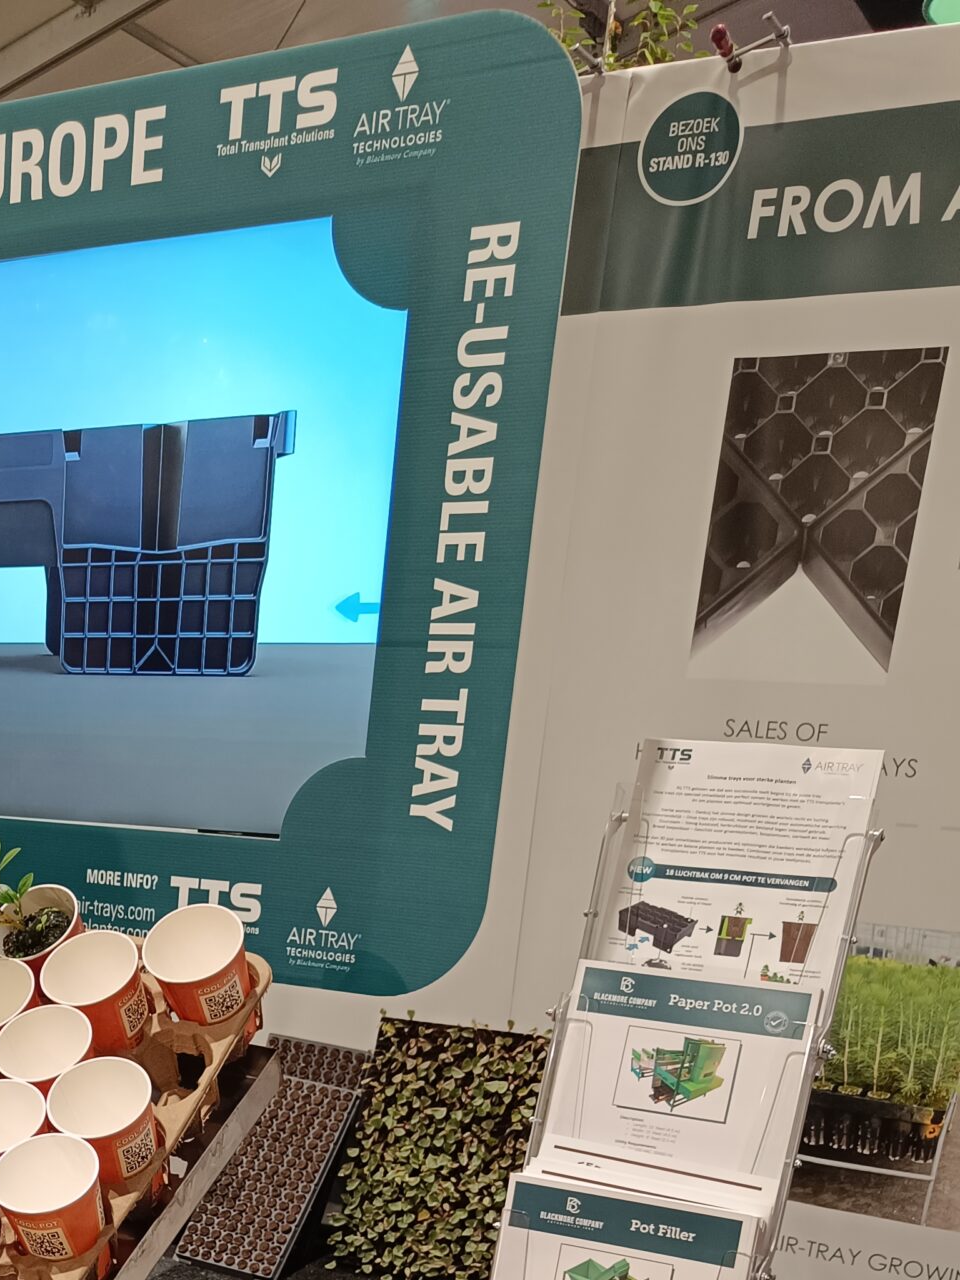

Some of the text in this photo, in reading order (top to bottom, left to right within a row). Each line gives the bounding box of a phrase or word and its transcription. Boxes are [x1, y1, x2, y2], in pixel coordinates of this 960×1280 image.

[219, 67, 339, 141] TTS
[668, 117, 721, 137] BEZOEK
[217, 128, 335, 157] Total Transplant Solutions
[352, 129, 443, 155] TECHNOLOGIES
[677, 135, 706, 153] ONS
[355, 147, 437, 166] by Blackmore Company
[648, 150, 730, 173] STAND R-130
[747, 171, 922, 239] FROM
[408, 219, 522, 834] RE-USABLE AIR TRAY
[722, 718, 829, 743] SALES OF
[657, 746, 693, 761] TTS
[86, 868, 159, 890] MORE INFO?
[629, 865, 653, 875] NEW
[665, 868, 674, 876] 18
[729, 873, 741, 881] CM
[742, 874, 756, 883] POT
[757, 876, 765, 884] TE
[766, 876, 810, 887] VERVANGEN
[170, 875, 263, 923] TTS
[286, 947, 356, 964] TECHNOLOGIES
[296, 958, 325, 969] Blackmore
[325, 961, 351, 973] Company
[197, 969, 237, 994] COOL POT
[594, 991, 657, 1008] BLACKMORE COMPANY
[668, 993, 762, 1017] Paper Pot 2.0
[116, 1132, 137, 1147] COOL
[540, 1210, 604, 1230] BLACKMORE COMPANY
[629, 1219, 696, 1243] Pot Filler
[776, 1234, 862, 1266] IR-TRAY
